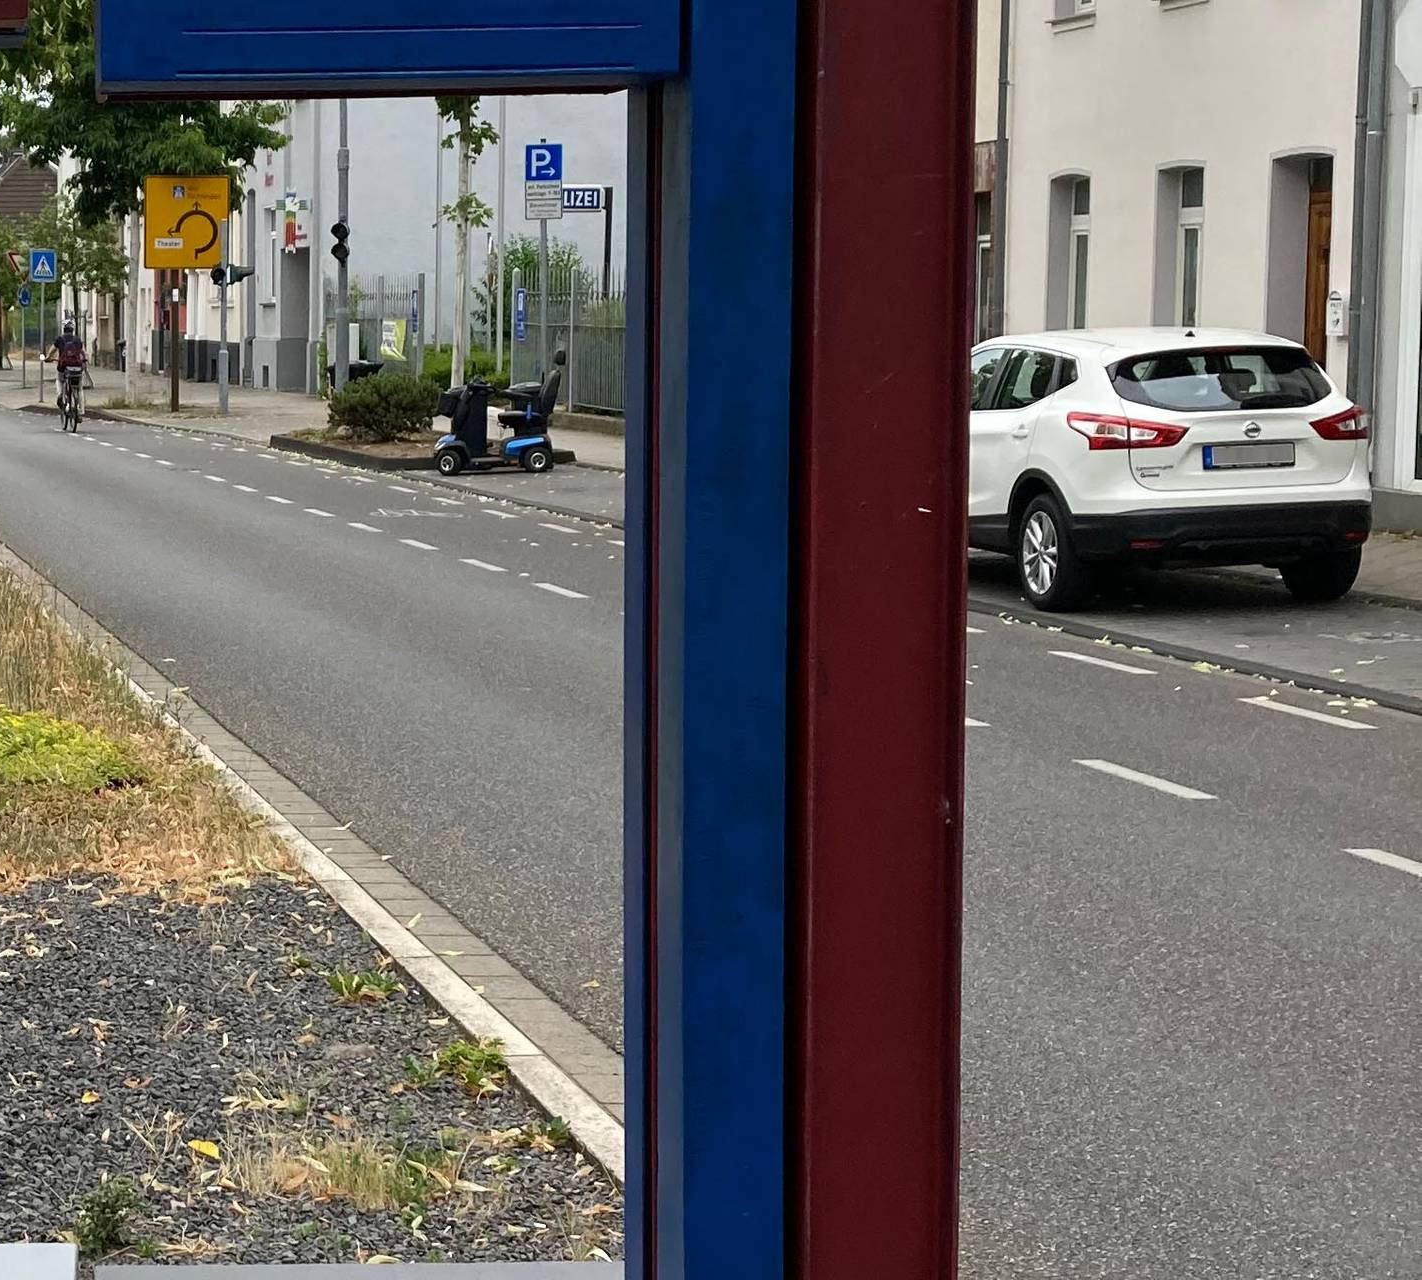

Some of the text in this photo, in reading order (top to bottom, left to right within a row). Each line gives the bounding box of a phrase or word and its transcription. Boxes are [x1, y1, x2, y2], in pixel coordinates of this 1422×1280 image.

[531, 148, 552, 177] P
[563, 190, 598, 207] LIZEI
[156, 240, 181, 248] Theater
